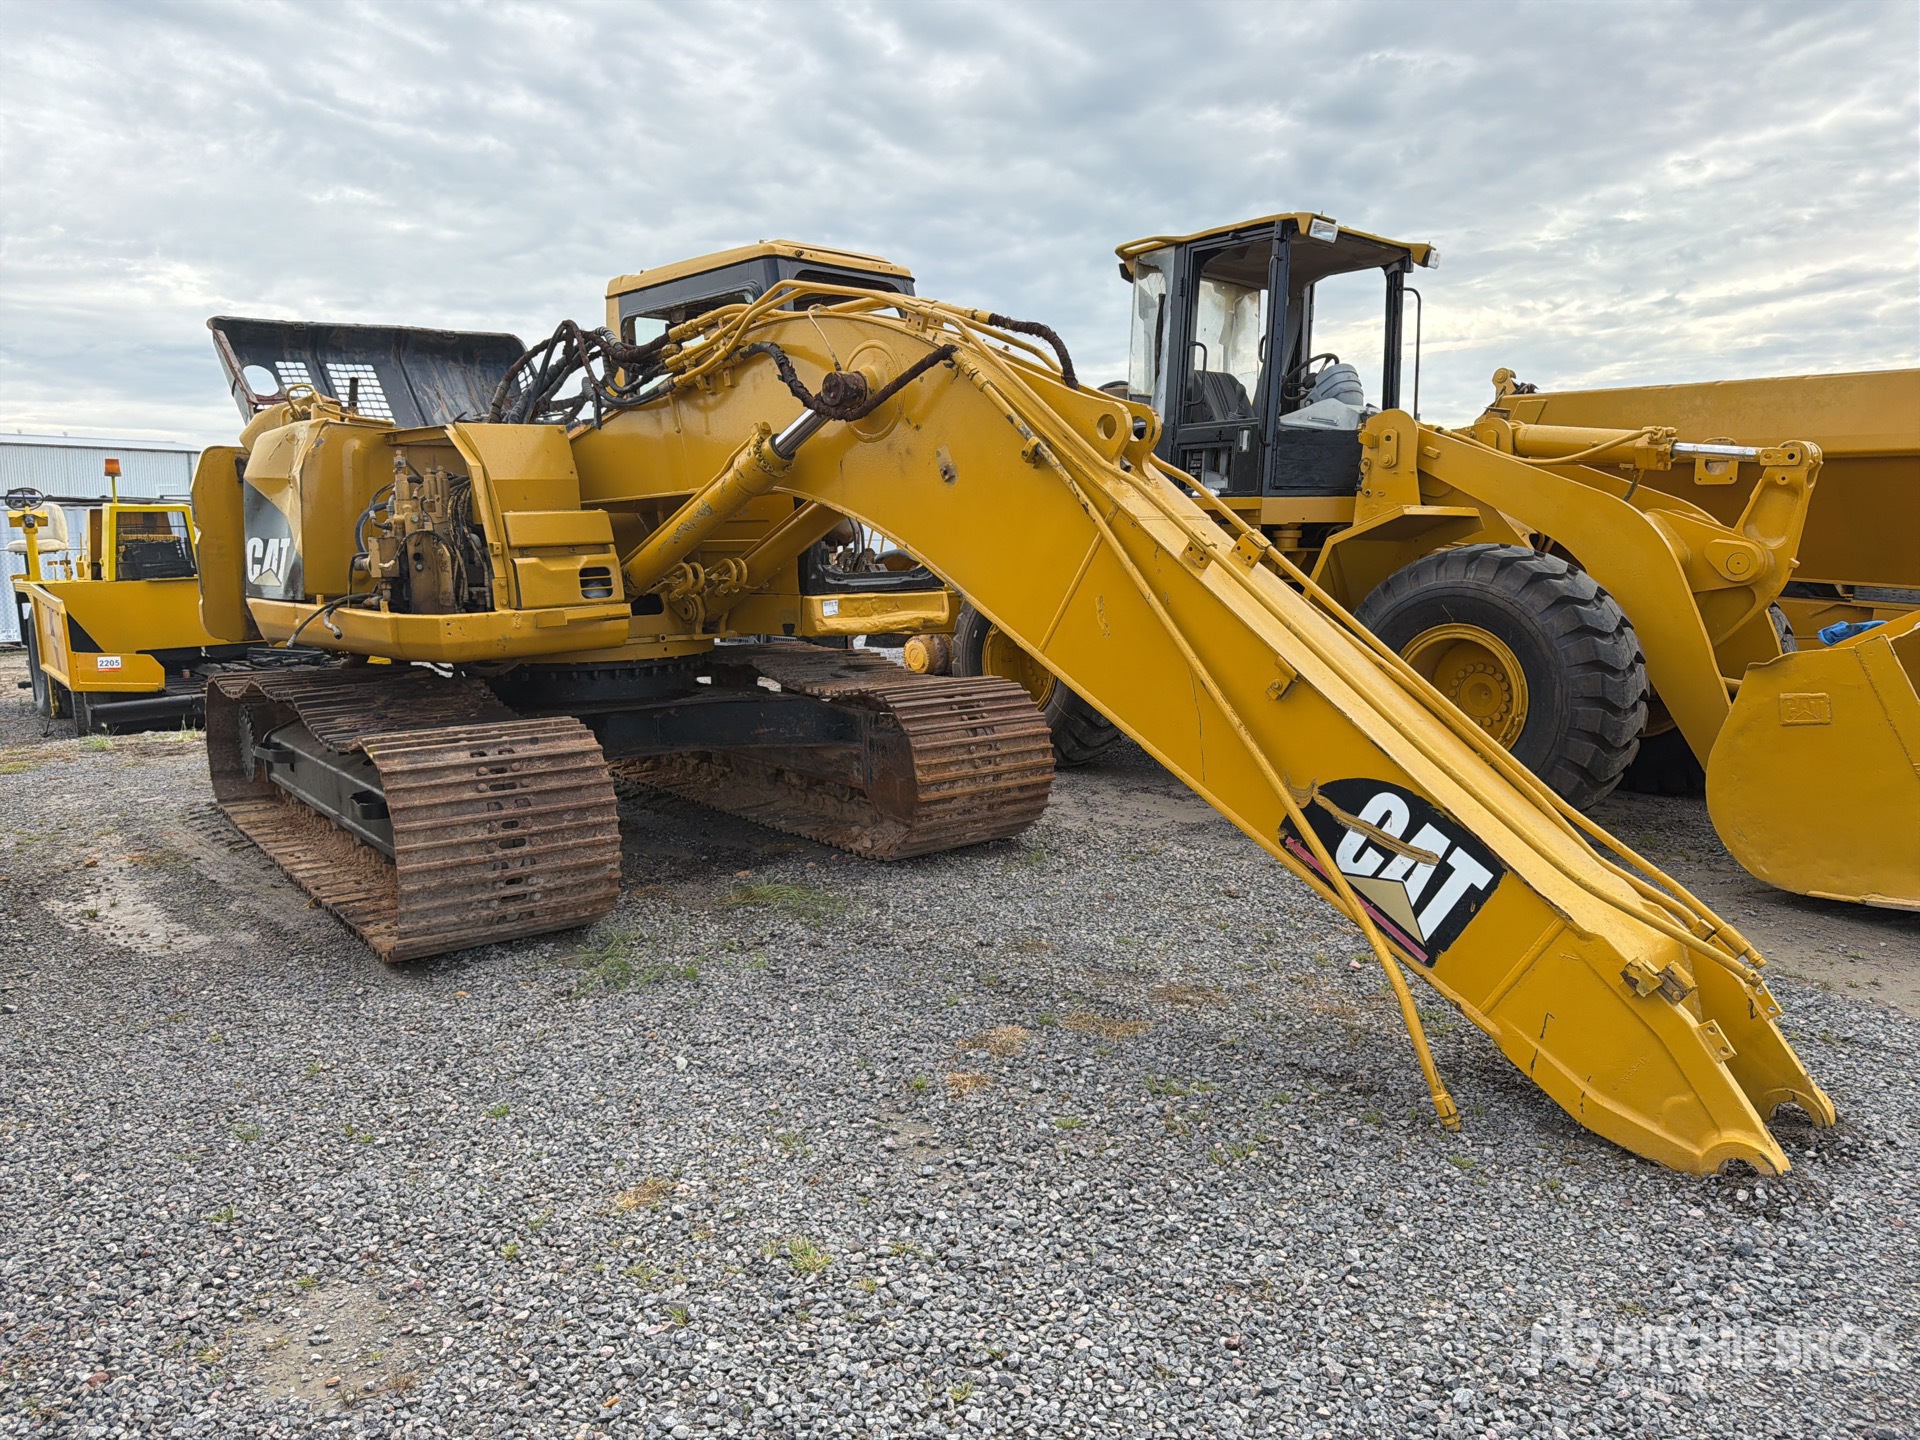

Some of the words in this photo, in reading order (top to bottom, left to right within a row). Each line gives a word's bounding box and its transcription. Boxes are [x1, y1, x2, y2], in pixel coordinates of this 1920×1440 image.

[247, 537, 291, 584] CAT
[99, 659, 120, 667] 2205
[1782, 698, 1825, 722] CAT
[1335, 791, 1494, 942] CAT
